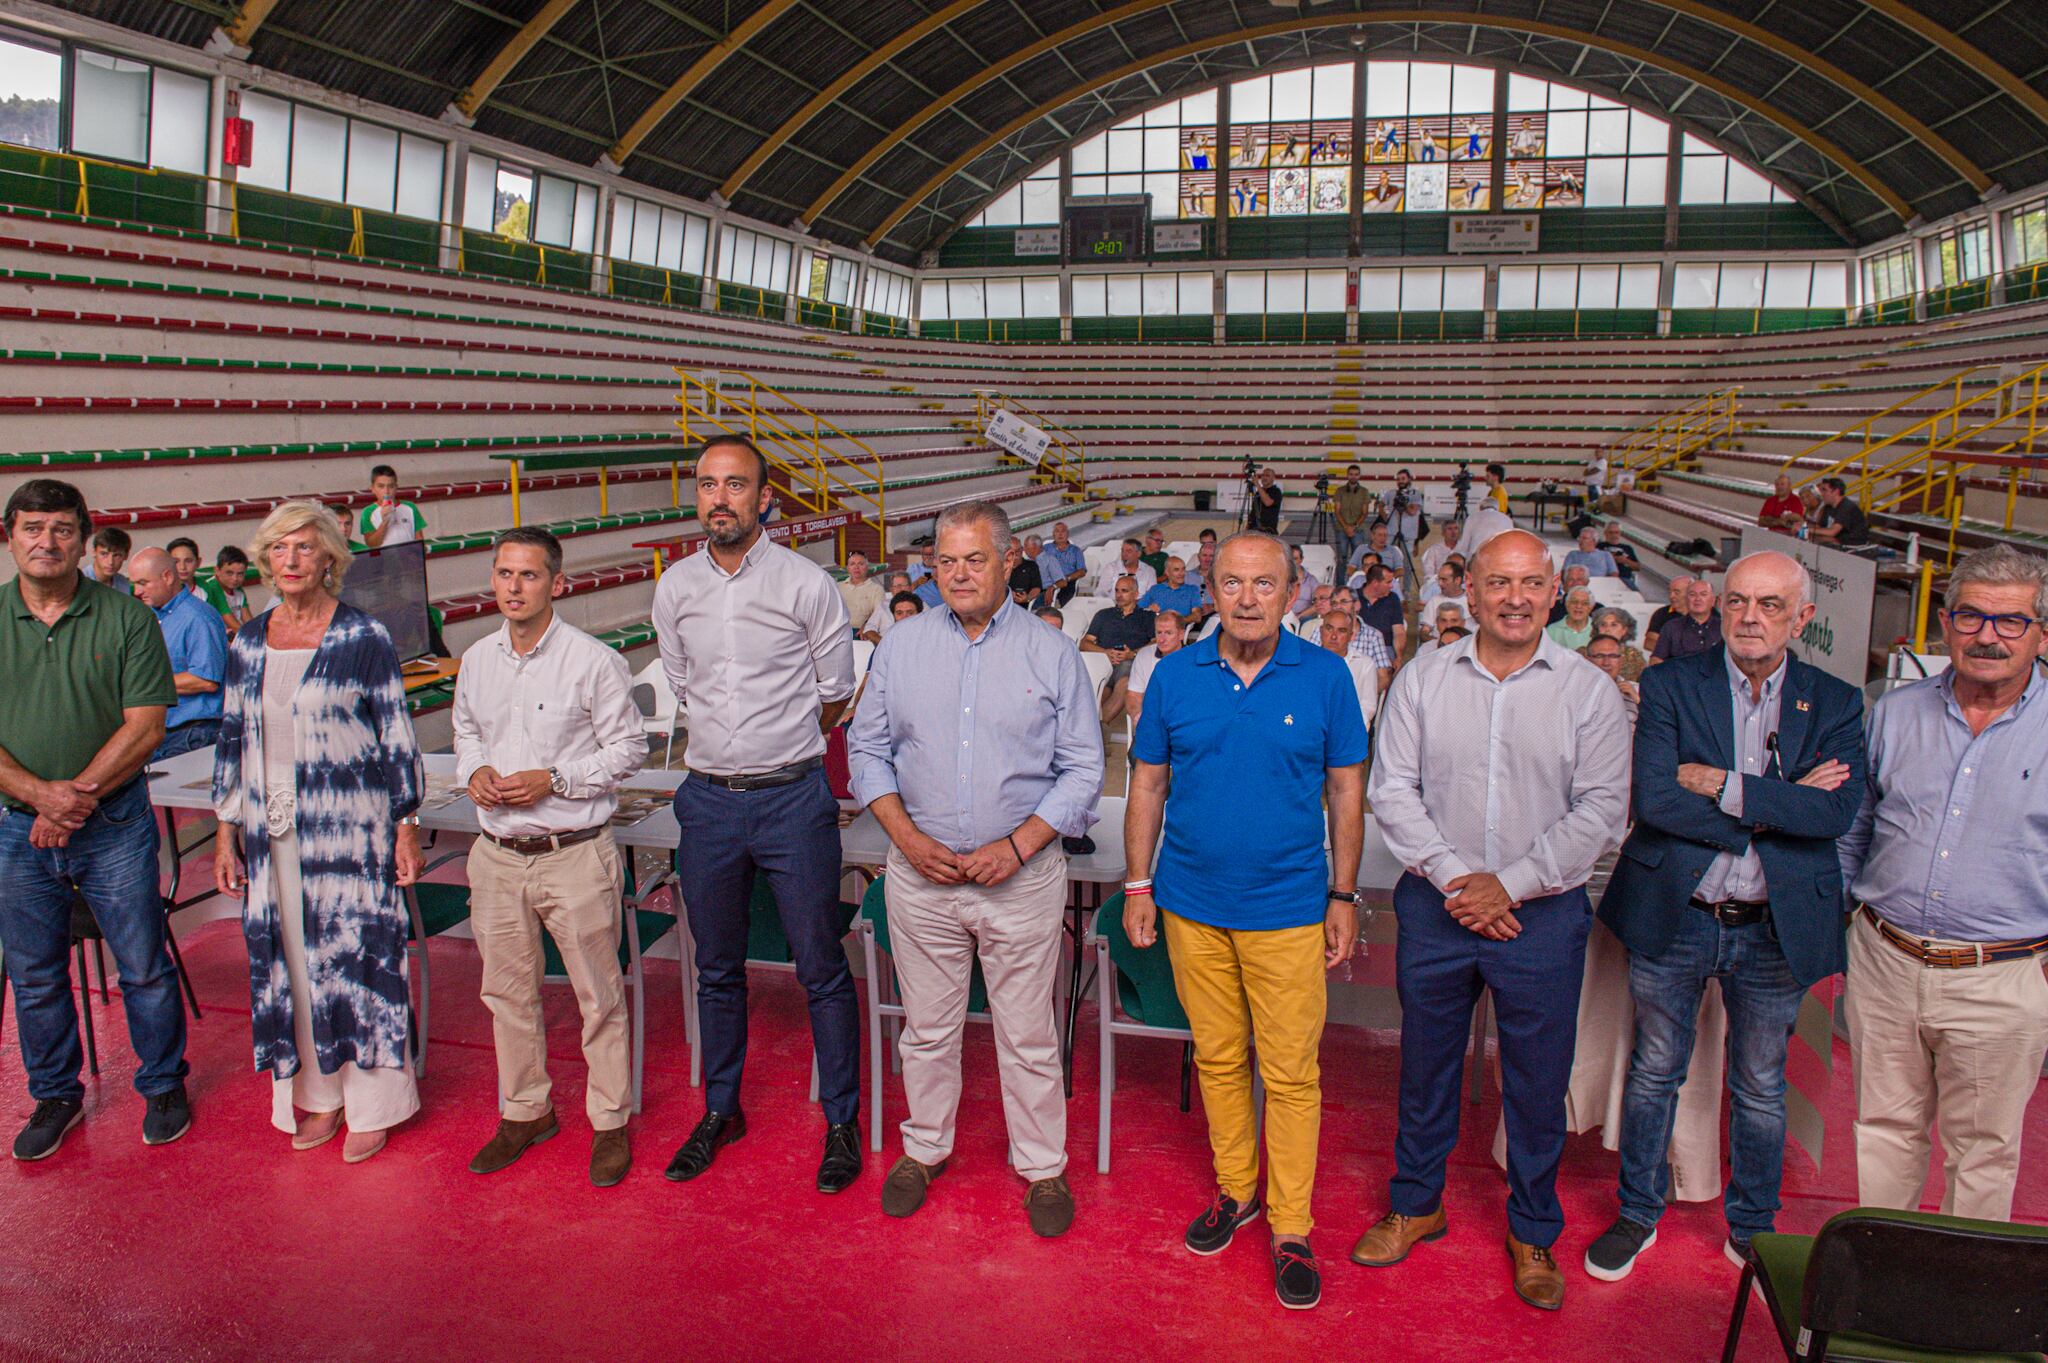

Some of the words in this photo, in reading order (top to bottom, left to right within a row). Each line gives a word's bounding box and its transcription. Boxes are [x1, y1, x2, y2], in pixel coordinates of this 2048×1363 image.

[1094, 241, 1122, 255] 12:07
[988, 427, 1007, 443] Sentir
[1008, 440, 1016, 448] el
[1016, 445, 1039, 462] deporte
[792, 523, 802, 534] DE
[805, 516, 848, 531] TORRELAVEGA
[1800, 615, 1834, 657] eporte
